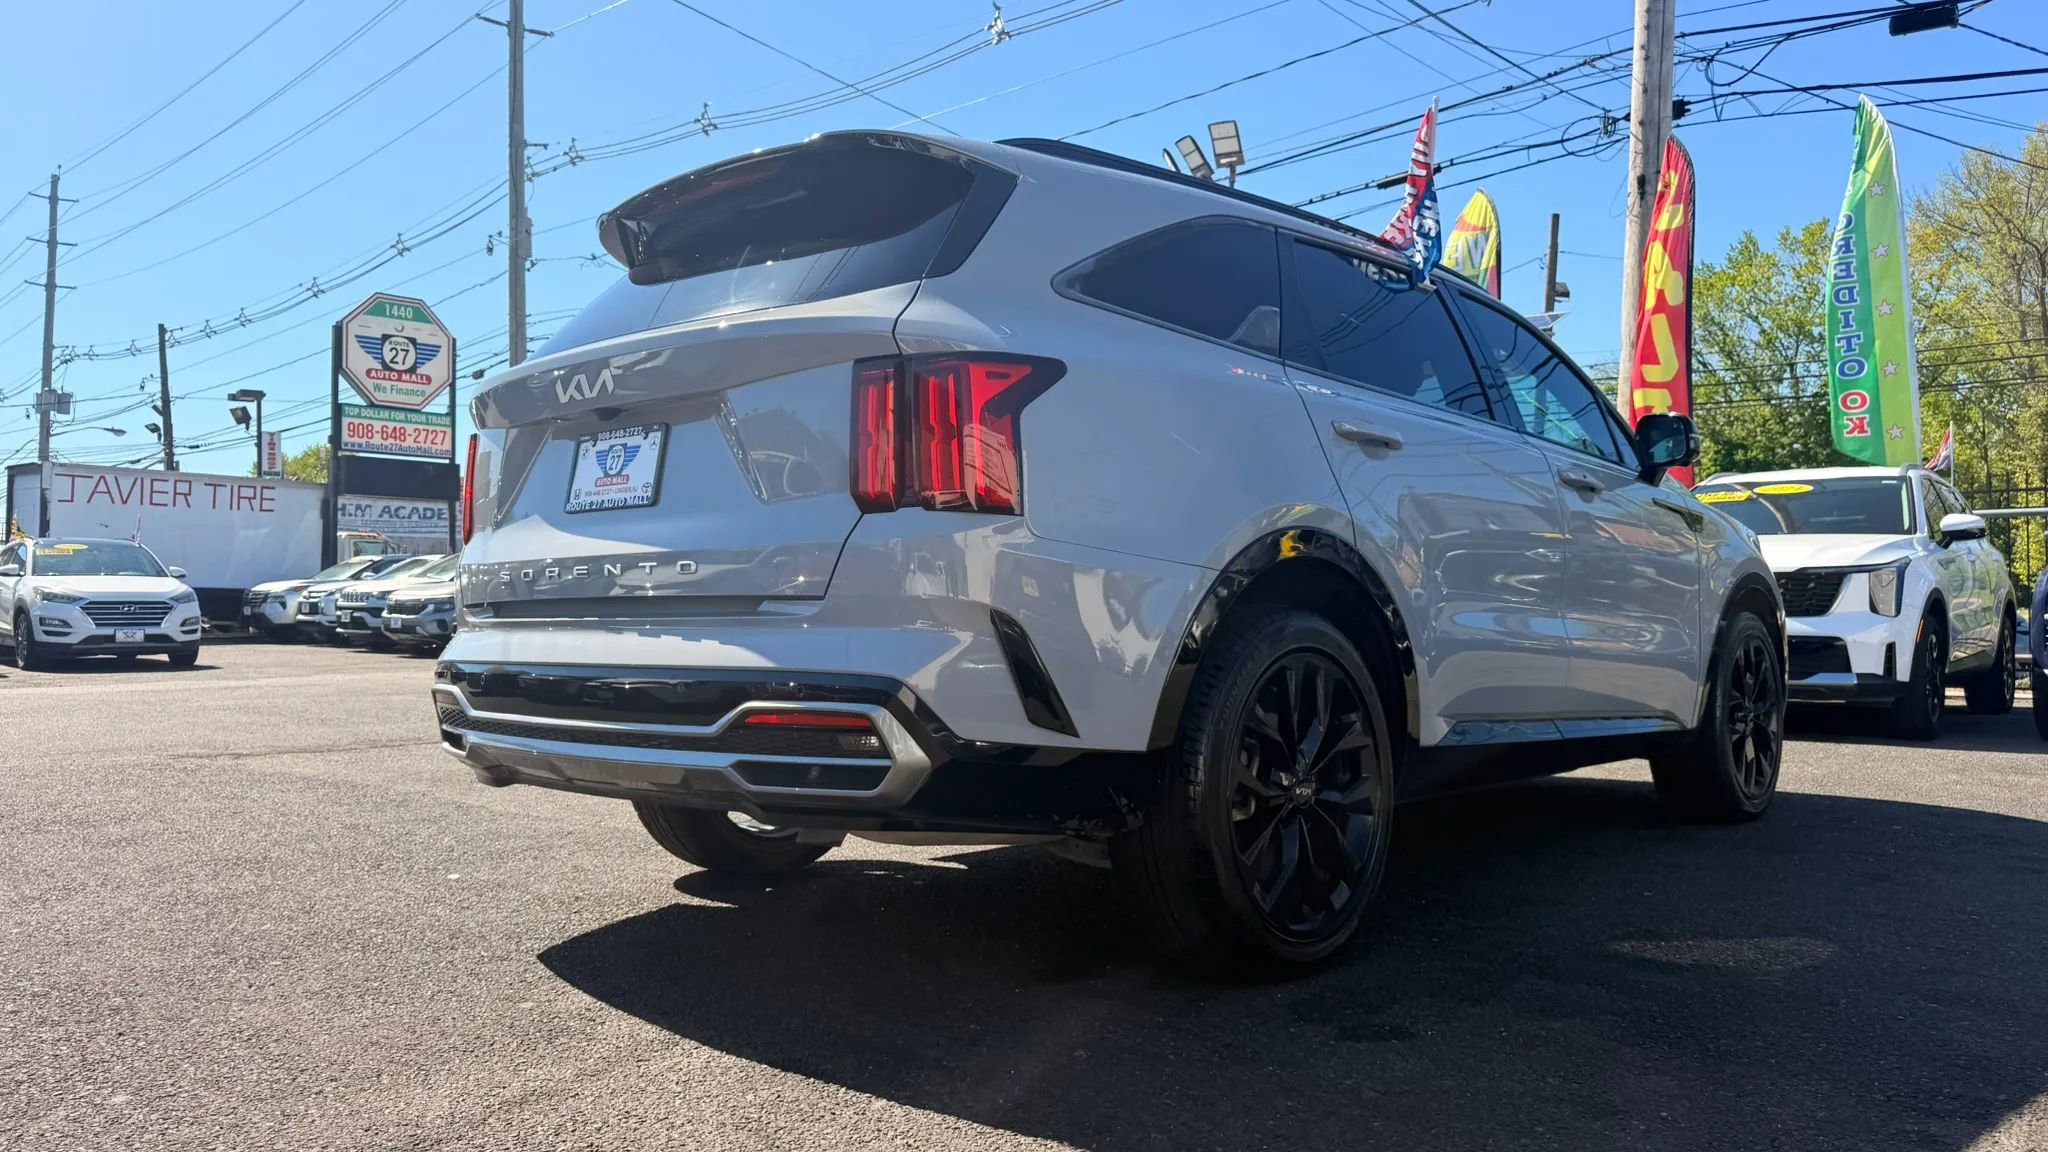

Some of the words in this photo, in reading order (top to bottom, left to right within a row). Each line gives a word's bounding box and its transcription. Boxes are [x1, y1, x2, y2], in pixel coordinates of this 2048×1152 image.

[385, 304, 413, 319] 1440
[388, 340, 411, 349] ROUTE
[389, 347, 410, 366] 27
[369, 369, 398, 380] AUTO
[401, 373, 429, 384] MALL
[372, 382, 387, 394] We
[390, 384, 427, 398] Finance
[555, 367, 615, 403] KIA
[344, 406, 359, 416] TOP
[361, 408, 390, 418] DOLLAR
[391, 410, 405, 420] FOR
[407, 413, 426, 422] YOUR
[428, 415, 451, 425] TRADE
[347, 421, 447, 446] 908-648-2727
[598, 426, 643, 441] 908-648-2727
[342, 440, 451, 456] www.Route27AutoMall.com
[608, 454, 621, 470] 27
[596, 477, 611, 486] AUTO
[612, 475, 628, 484] MALL
[54, 472, 192, 509] JAVIER
[204, 482, 276, 513] TIRE
[566, 501, 591, 512] ROUTE
[592, 500, 601, 508] 27
[602, 497, 625, 508] AUTO
[627, 495, 649, 505] MALL
[499, 560, 698, 582] SORENTO
